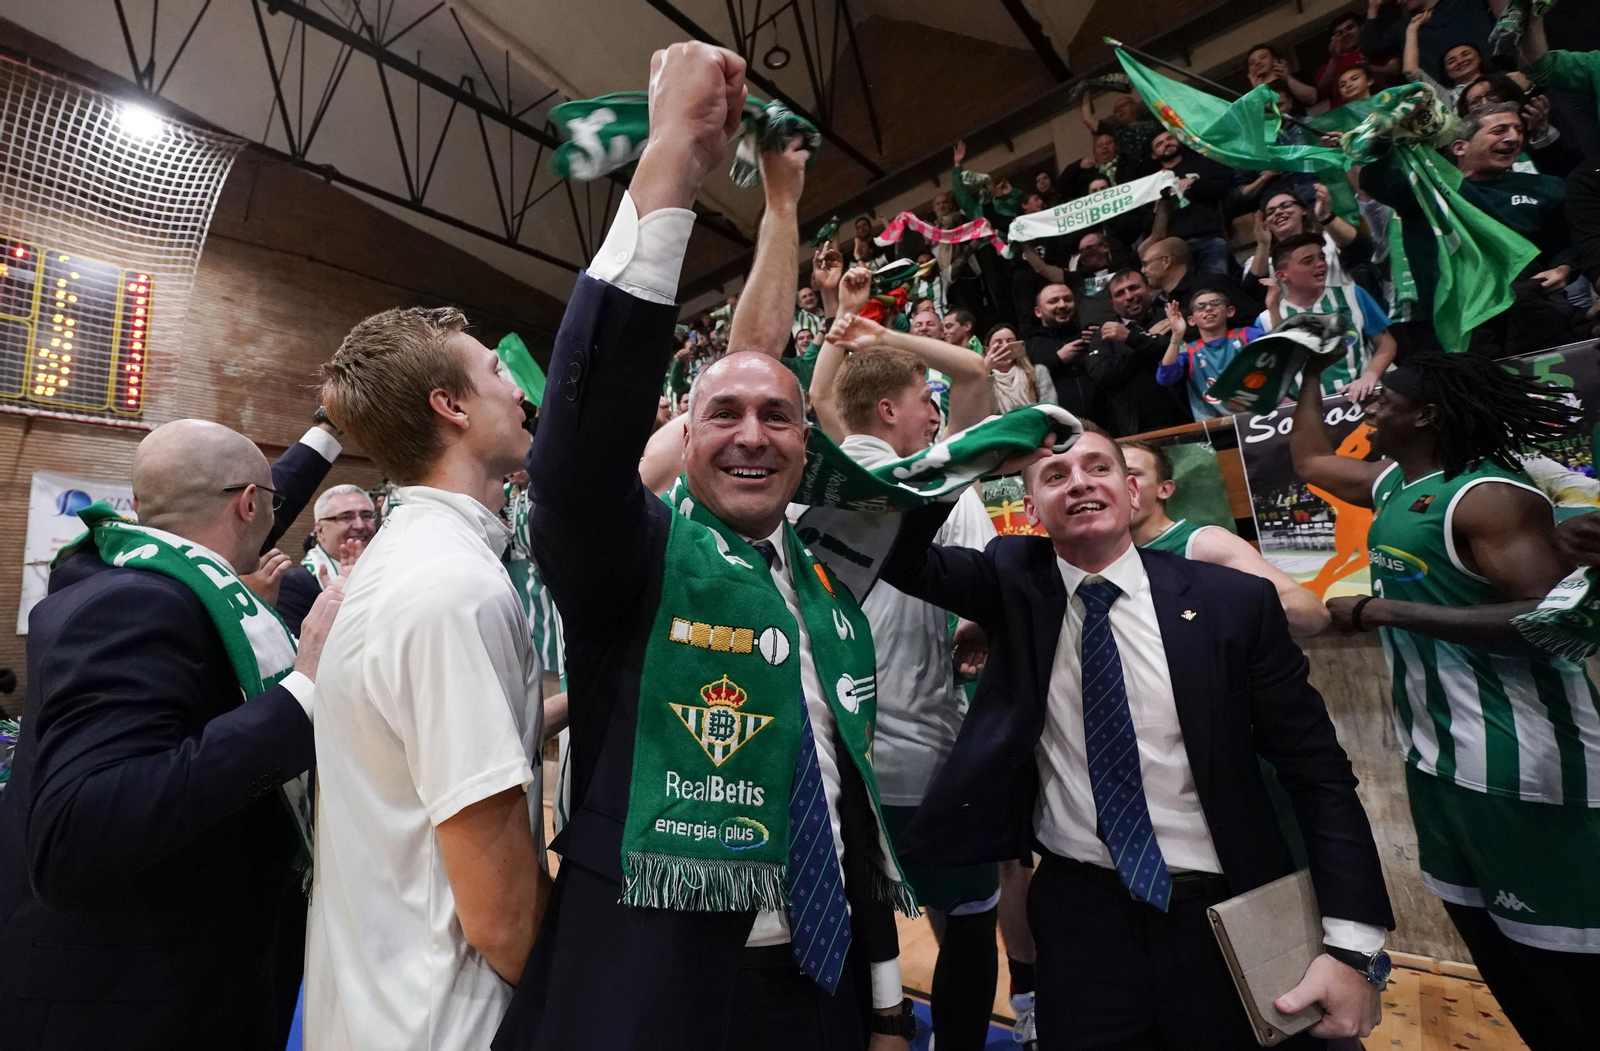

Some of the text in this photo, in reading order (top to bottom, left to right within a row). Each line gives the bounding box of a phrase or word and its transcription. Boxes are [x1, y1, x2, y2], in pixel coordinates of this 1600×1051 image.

[1245, 402, 1365, 444] Soos
[666, 770, 765, 807] RealBetis
[655, 820, 755, 844] energia plus
